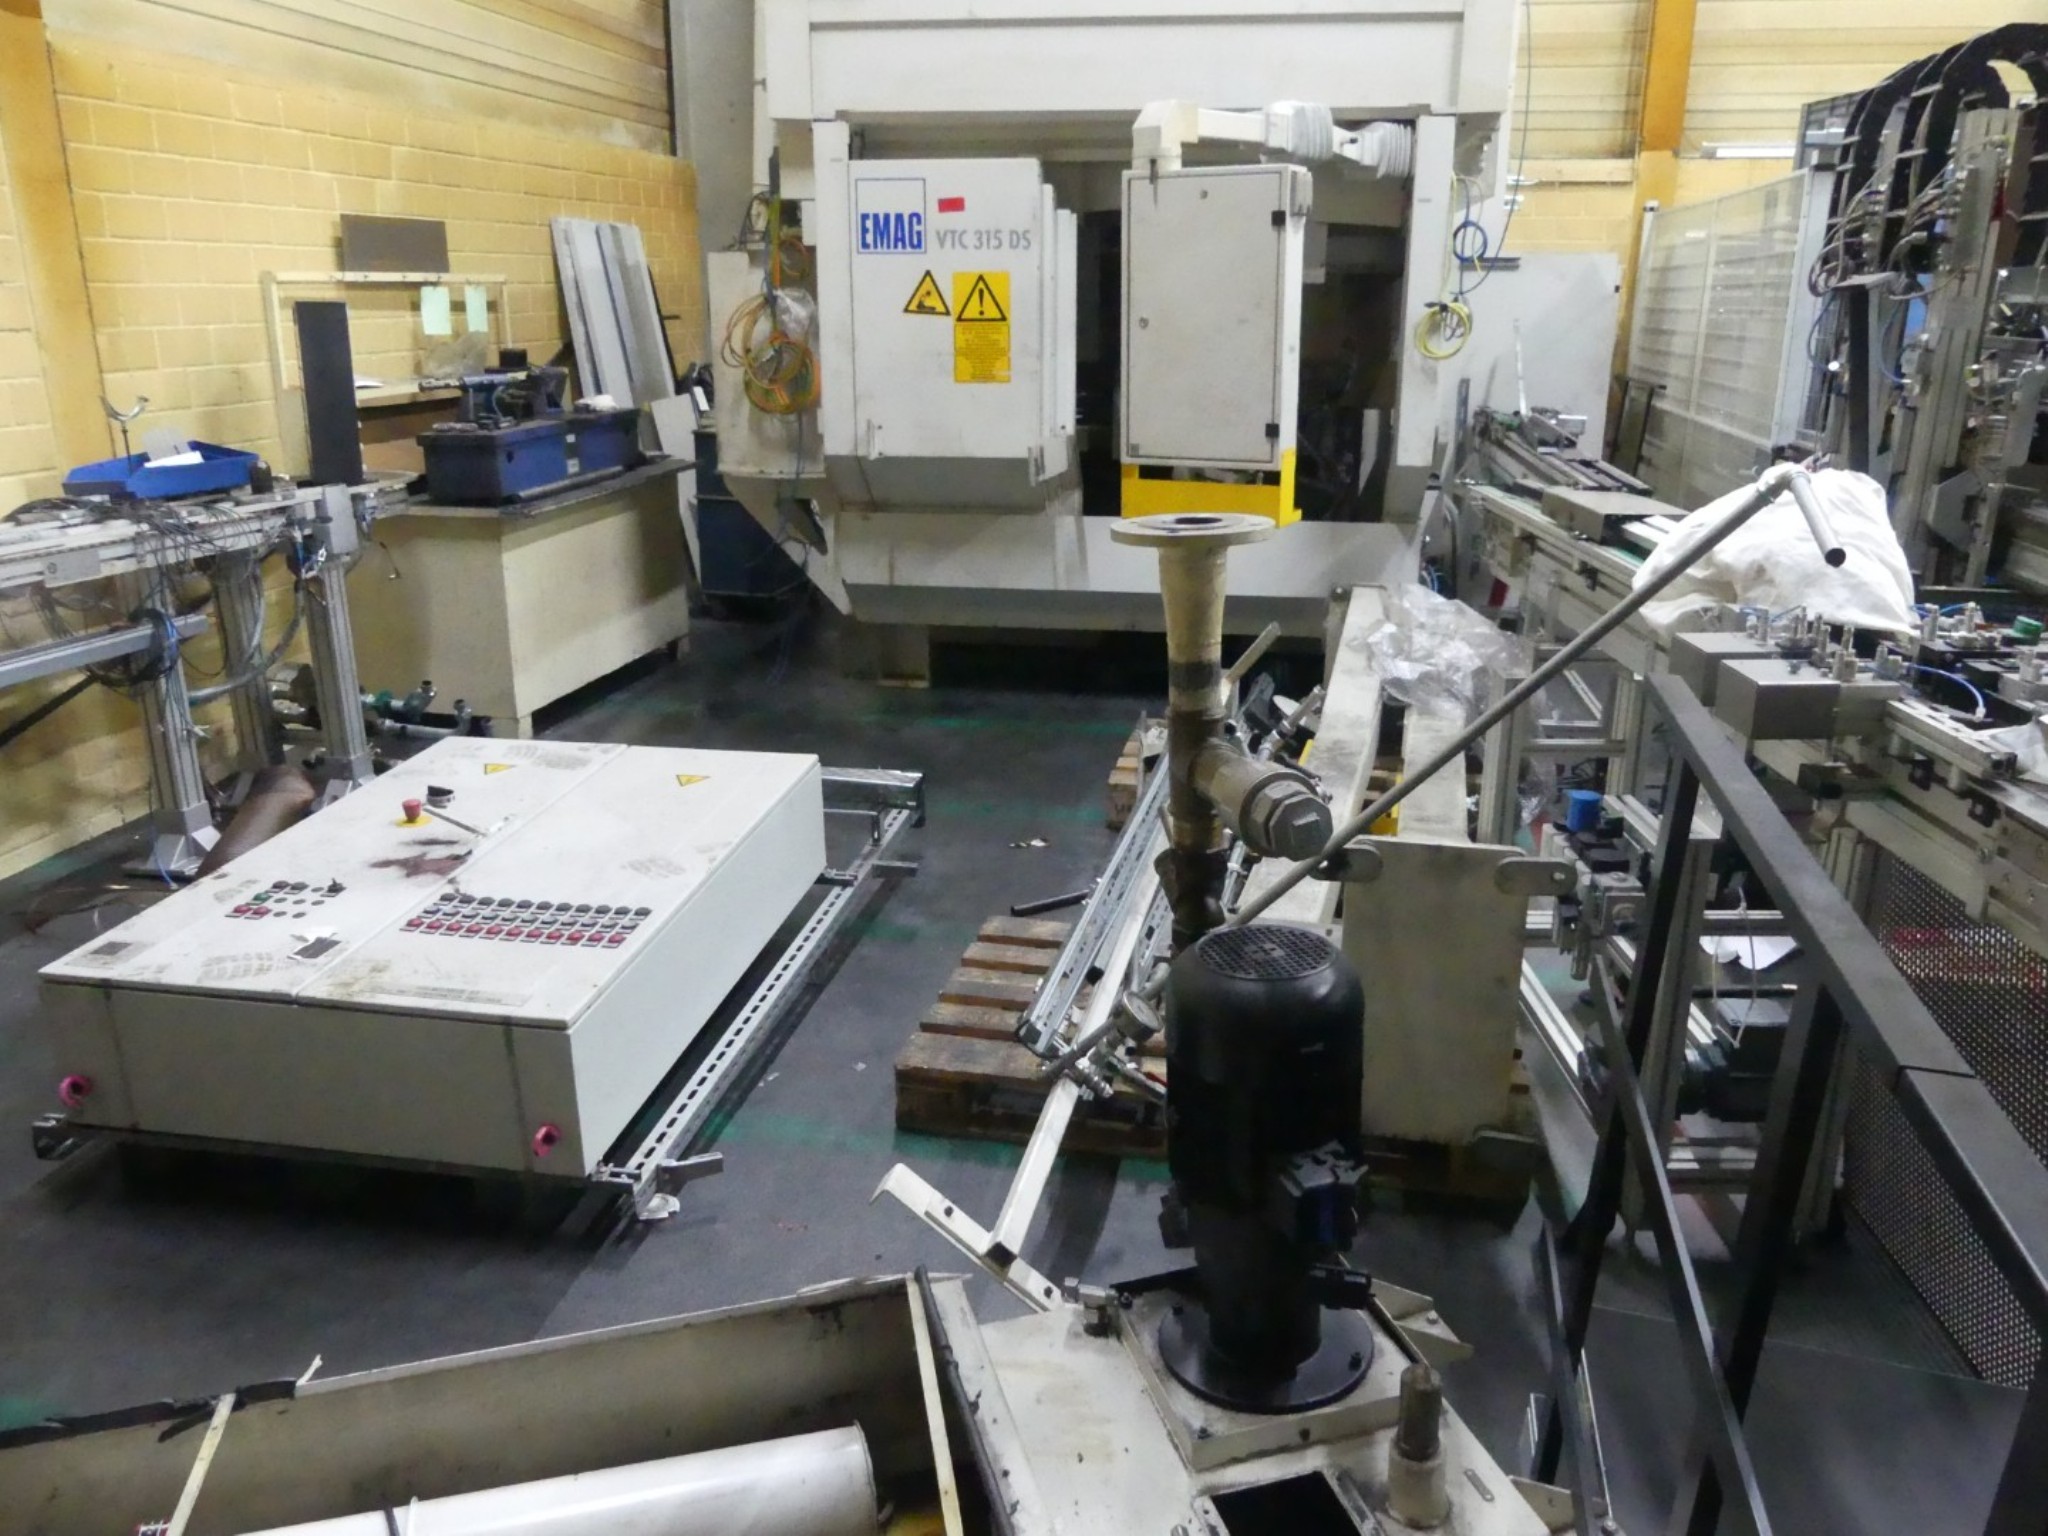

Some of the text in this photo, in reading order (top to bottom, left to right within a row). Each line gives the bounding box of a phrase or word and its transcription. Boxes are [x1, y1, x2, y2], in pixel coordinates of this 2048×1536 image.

[860, 211, 922, 250] EMAG
[936, 229, 1032, 250] VTC 315 DS
